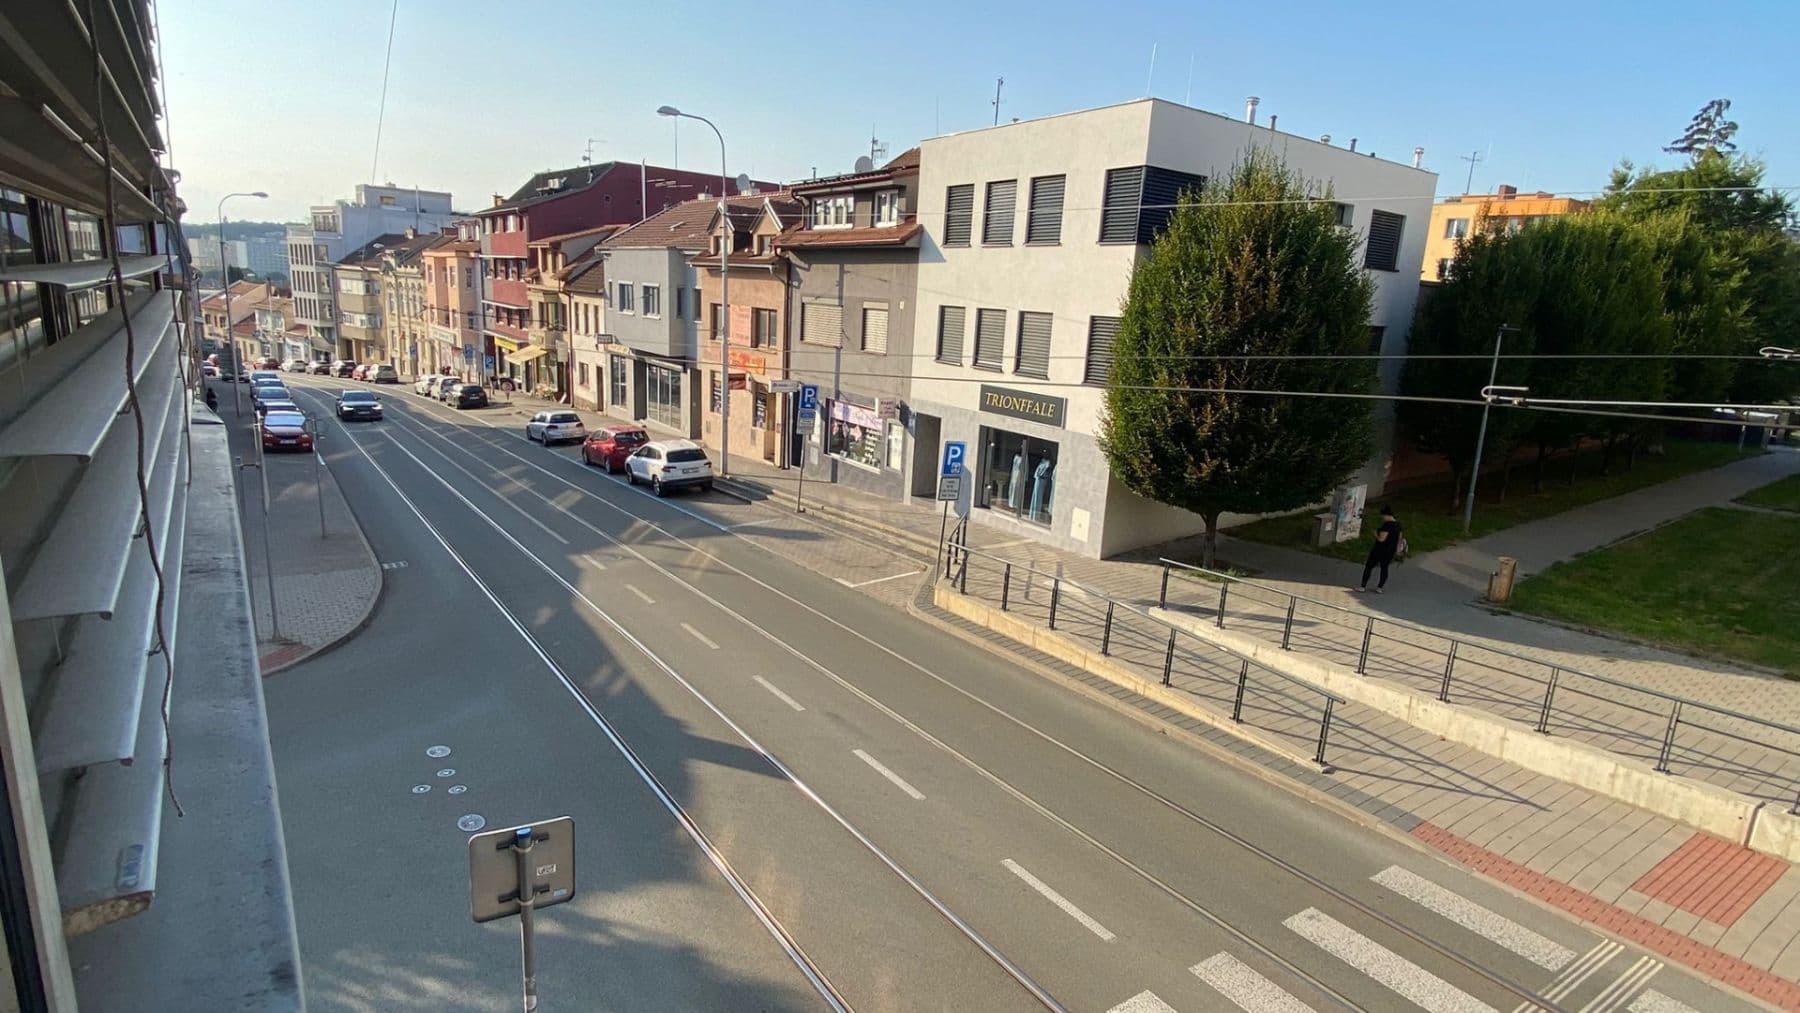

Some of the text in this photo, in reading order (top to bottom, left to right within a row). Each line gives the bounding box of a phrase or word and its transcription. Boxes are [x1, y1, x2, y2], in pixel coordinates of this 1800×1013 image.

[804, 388, 815, 402] P
[985, 392, 1056, 418] TRIONFFALE
[947, 446, 961, 465] P
